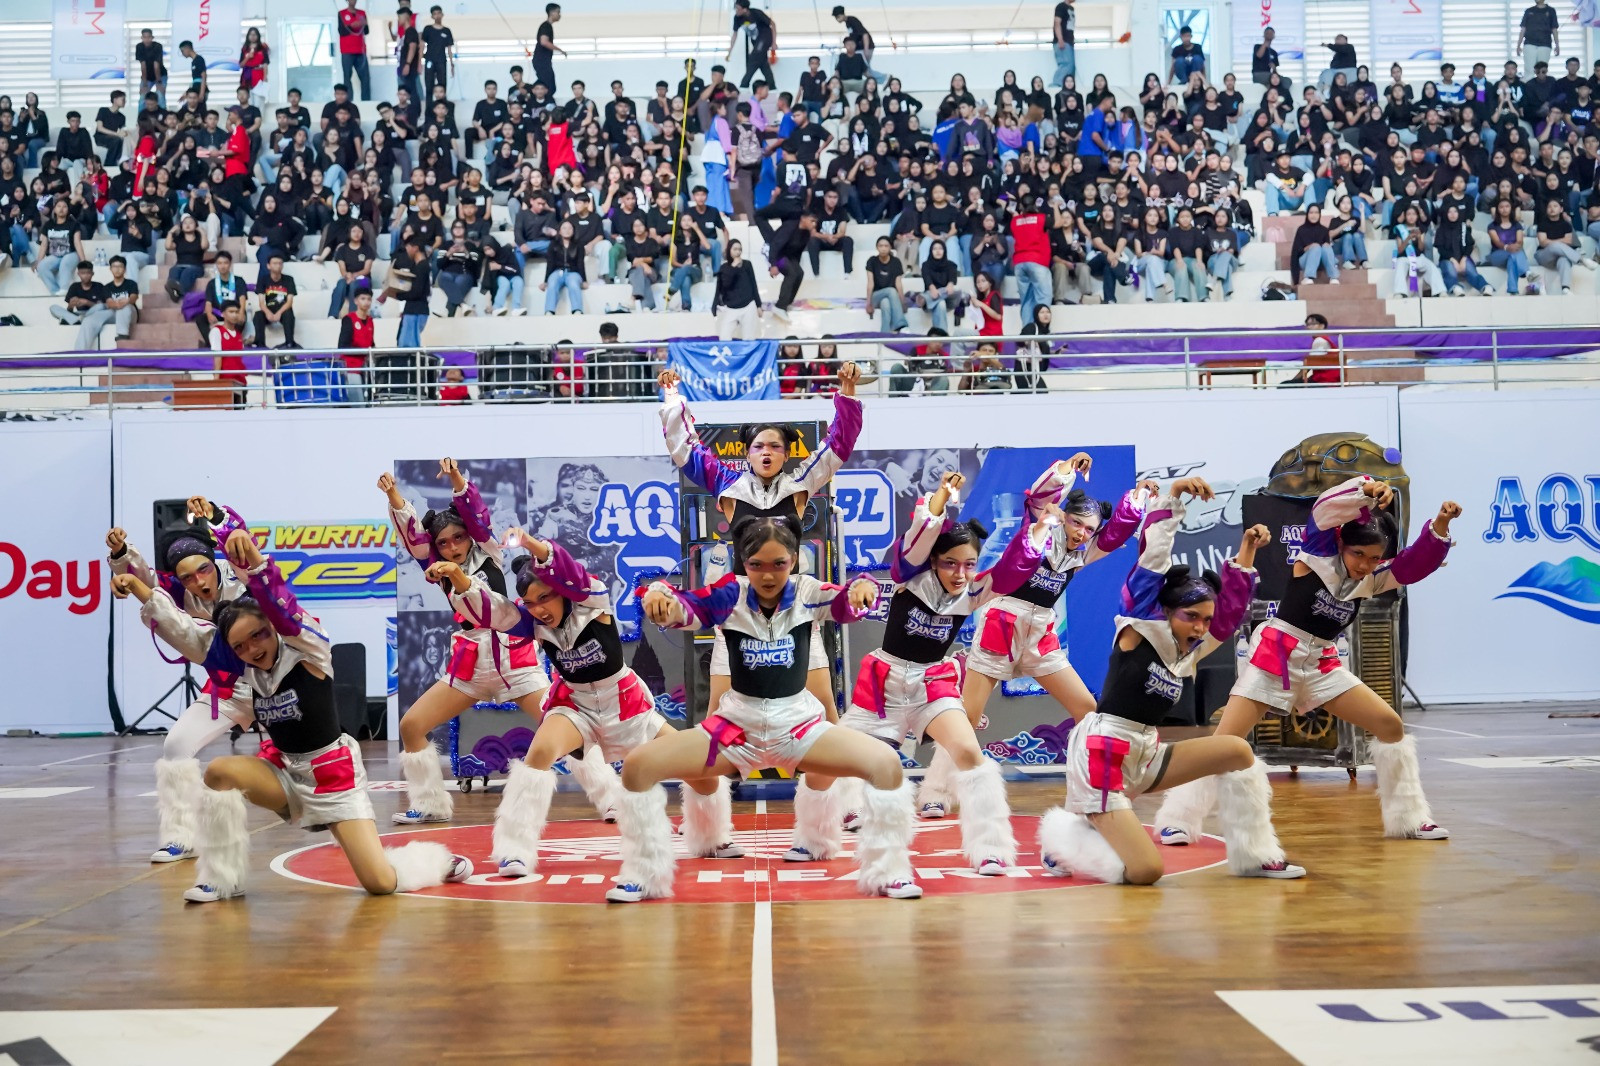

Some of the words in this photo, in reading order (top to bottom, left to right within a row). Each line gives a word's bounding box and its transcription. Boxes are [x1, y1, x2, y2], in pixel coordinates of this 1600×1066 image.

[594, 486, 681, 544] AQ
[275, 524, 389, 549] WORTH
[1029, 573, 1060, 592] DANCE
[1310, 599, 1349, 620] DANCE
[906, 618, 946, 638] DANCE
[562, 652, 600, 673] DANCE
[743, 649, 788, 669] DANCE
[1145, 675, 1181, 698] DANCE
[257, 704, 294, 726] DANCE
